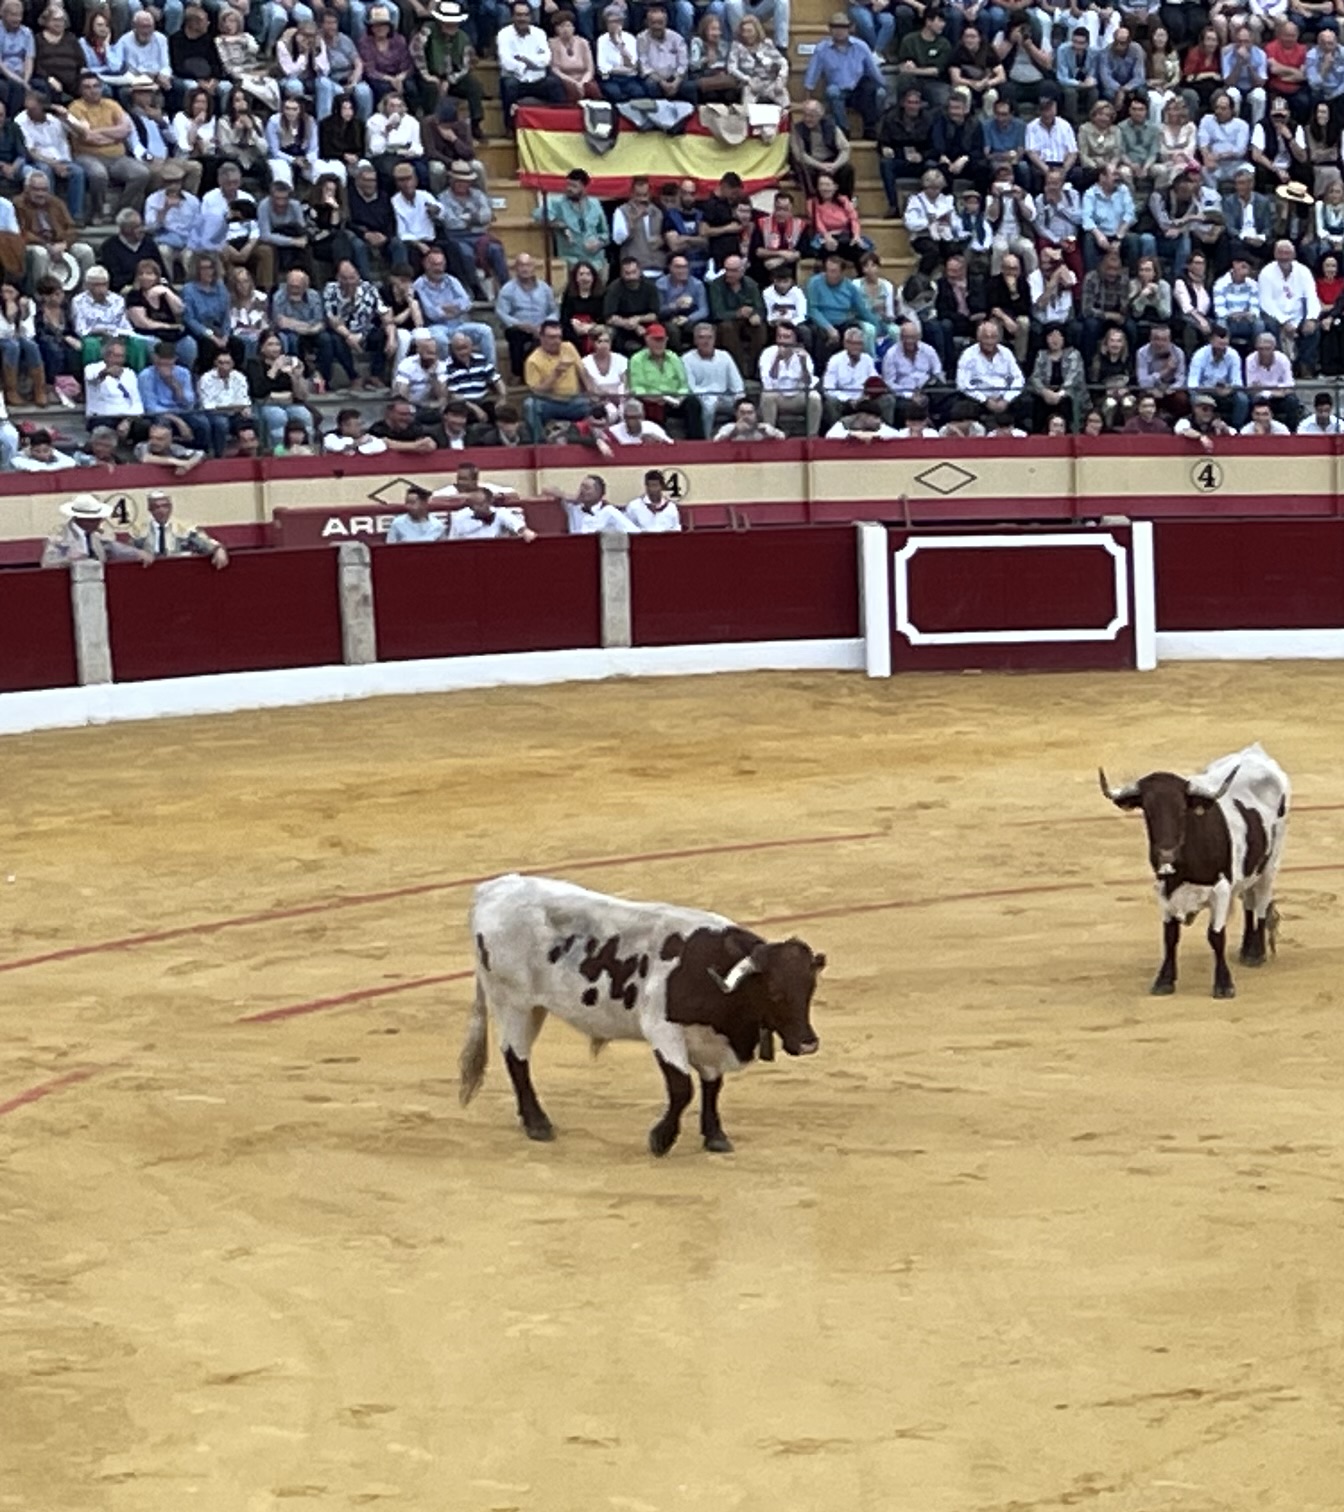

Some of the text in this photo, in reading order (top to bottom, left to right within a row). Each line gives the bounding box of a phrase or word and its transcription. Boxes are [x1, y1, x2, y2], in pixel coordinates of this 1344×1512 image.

[664, 472, 682, 498] 4
[1197, 463, 1216, 488] 4
[110, 497, 130, 525] 4
